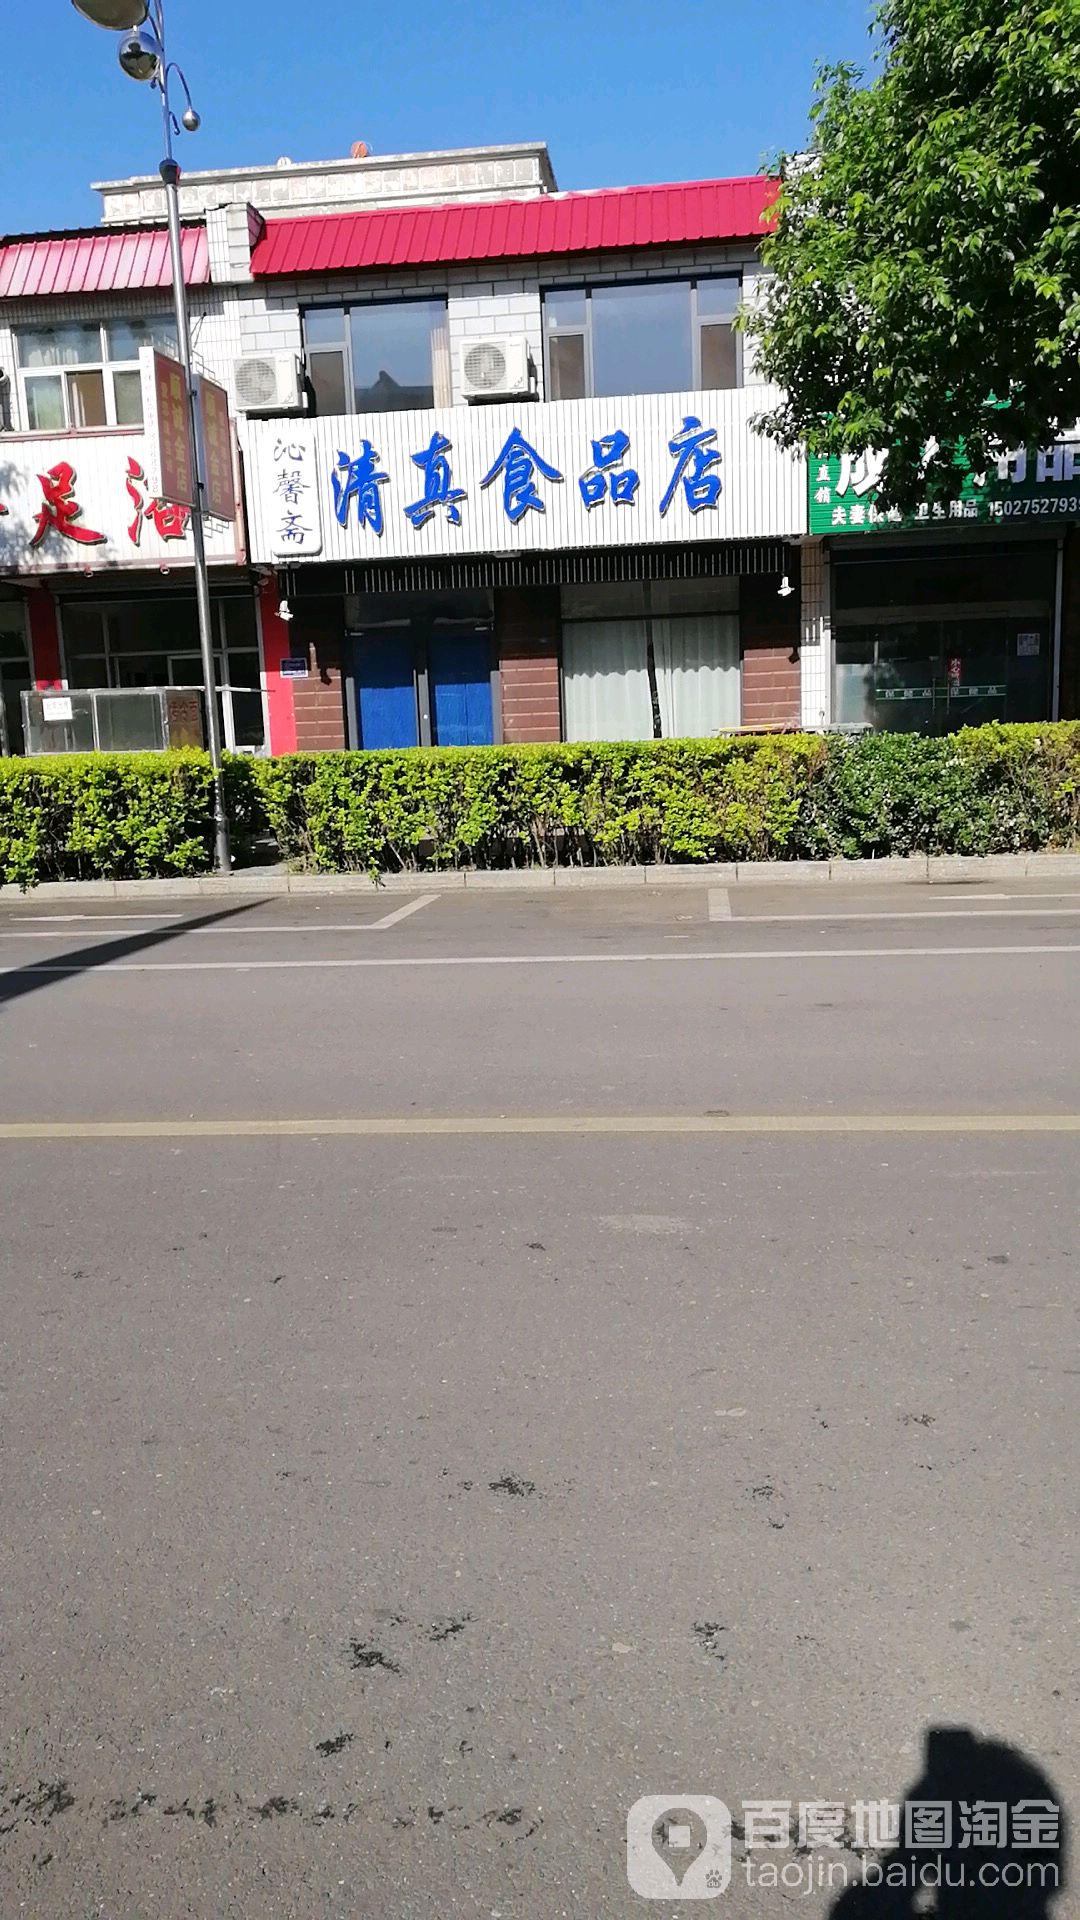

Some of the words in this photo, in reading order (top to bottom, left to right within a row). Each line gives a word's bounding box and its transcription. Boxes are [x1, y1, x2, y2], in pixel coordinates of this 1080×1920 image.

[272, 437, 313, 546] 沁馨斋
[332, 415, 722, 537] 清真食品店
[987, 497, 1080, 517] 1502752793
[914, 499, 978, 520] 卫生用品
